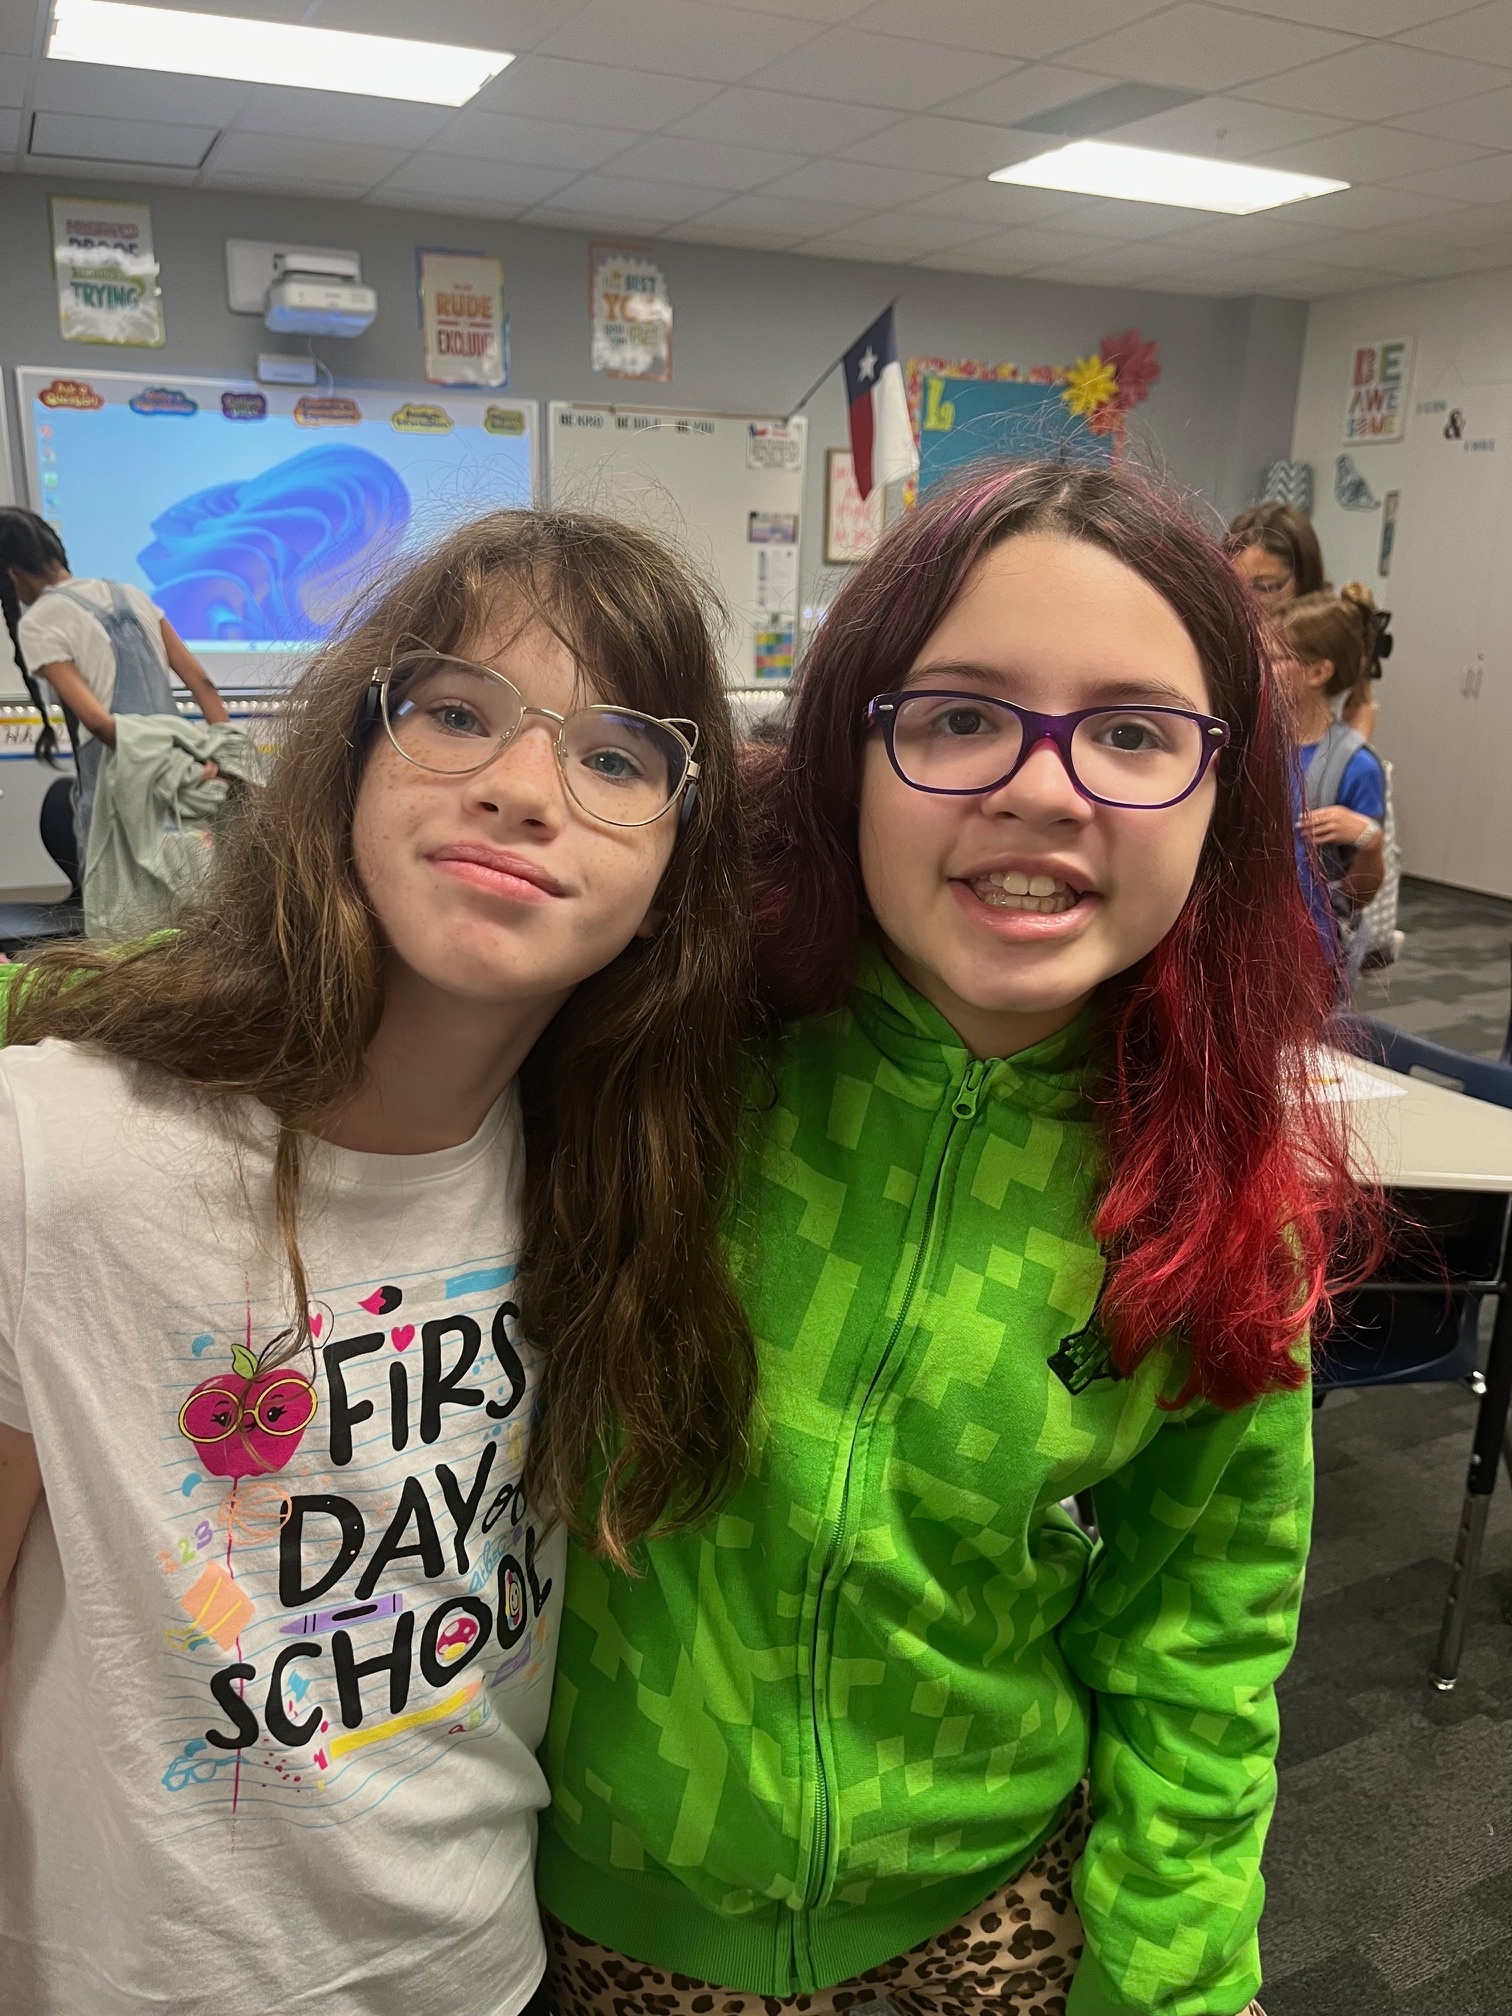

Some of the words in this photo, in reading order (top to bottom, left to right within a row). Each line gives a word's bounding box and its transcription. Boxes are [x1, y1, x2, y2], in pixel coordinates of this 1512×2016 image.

[70, 281, 140, 309] TRYING
[436, 292, 493, 320] RUDE
[1352, 343, 1405, 387] BE
[1347, 386, 1400, 413] AWE
[1443, 407, 1465, 440] &
[322, 1300, 527, 1466] FiRS
[278, 1440, 497, 1607] DAY
[205, 1524, 553, 1750] SCHOOL
